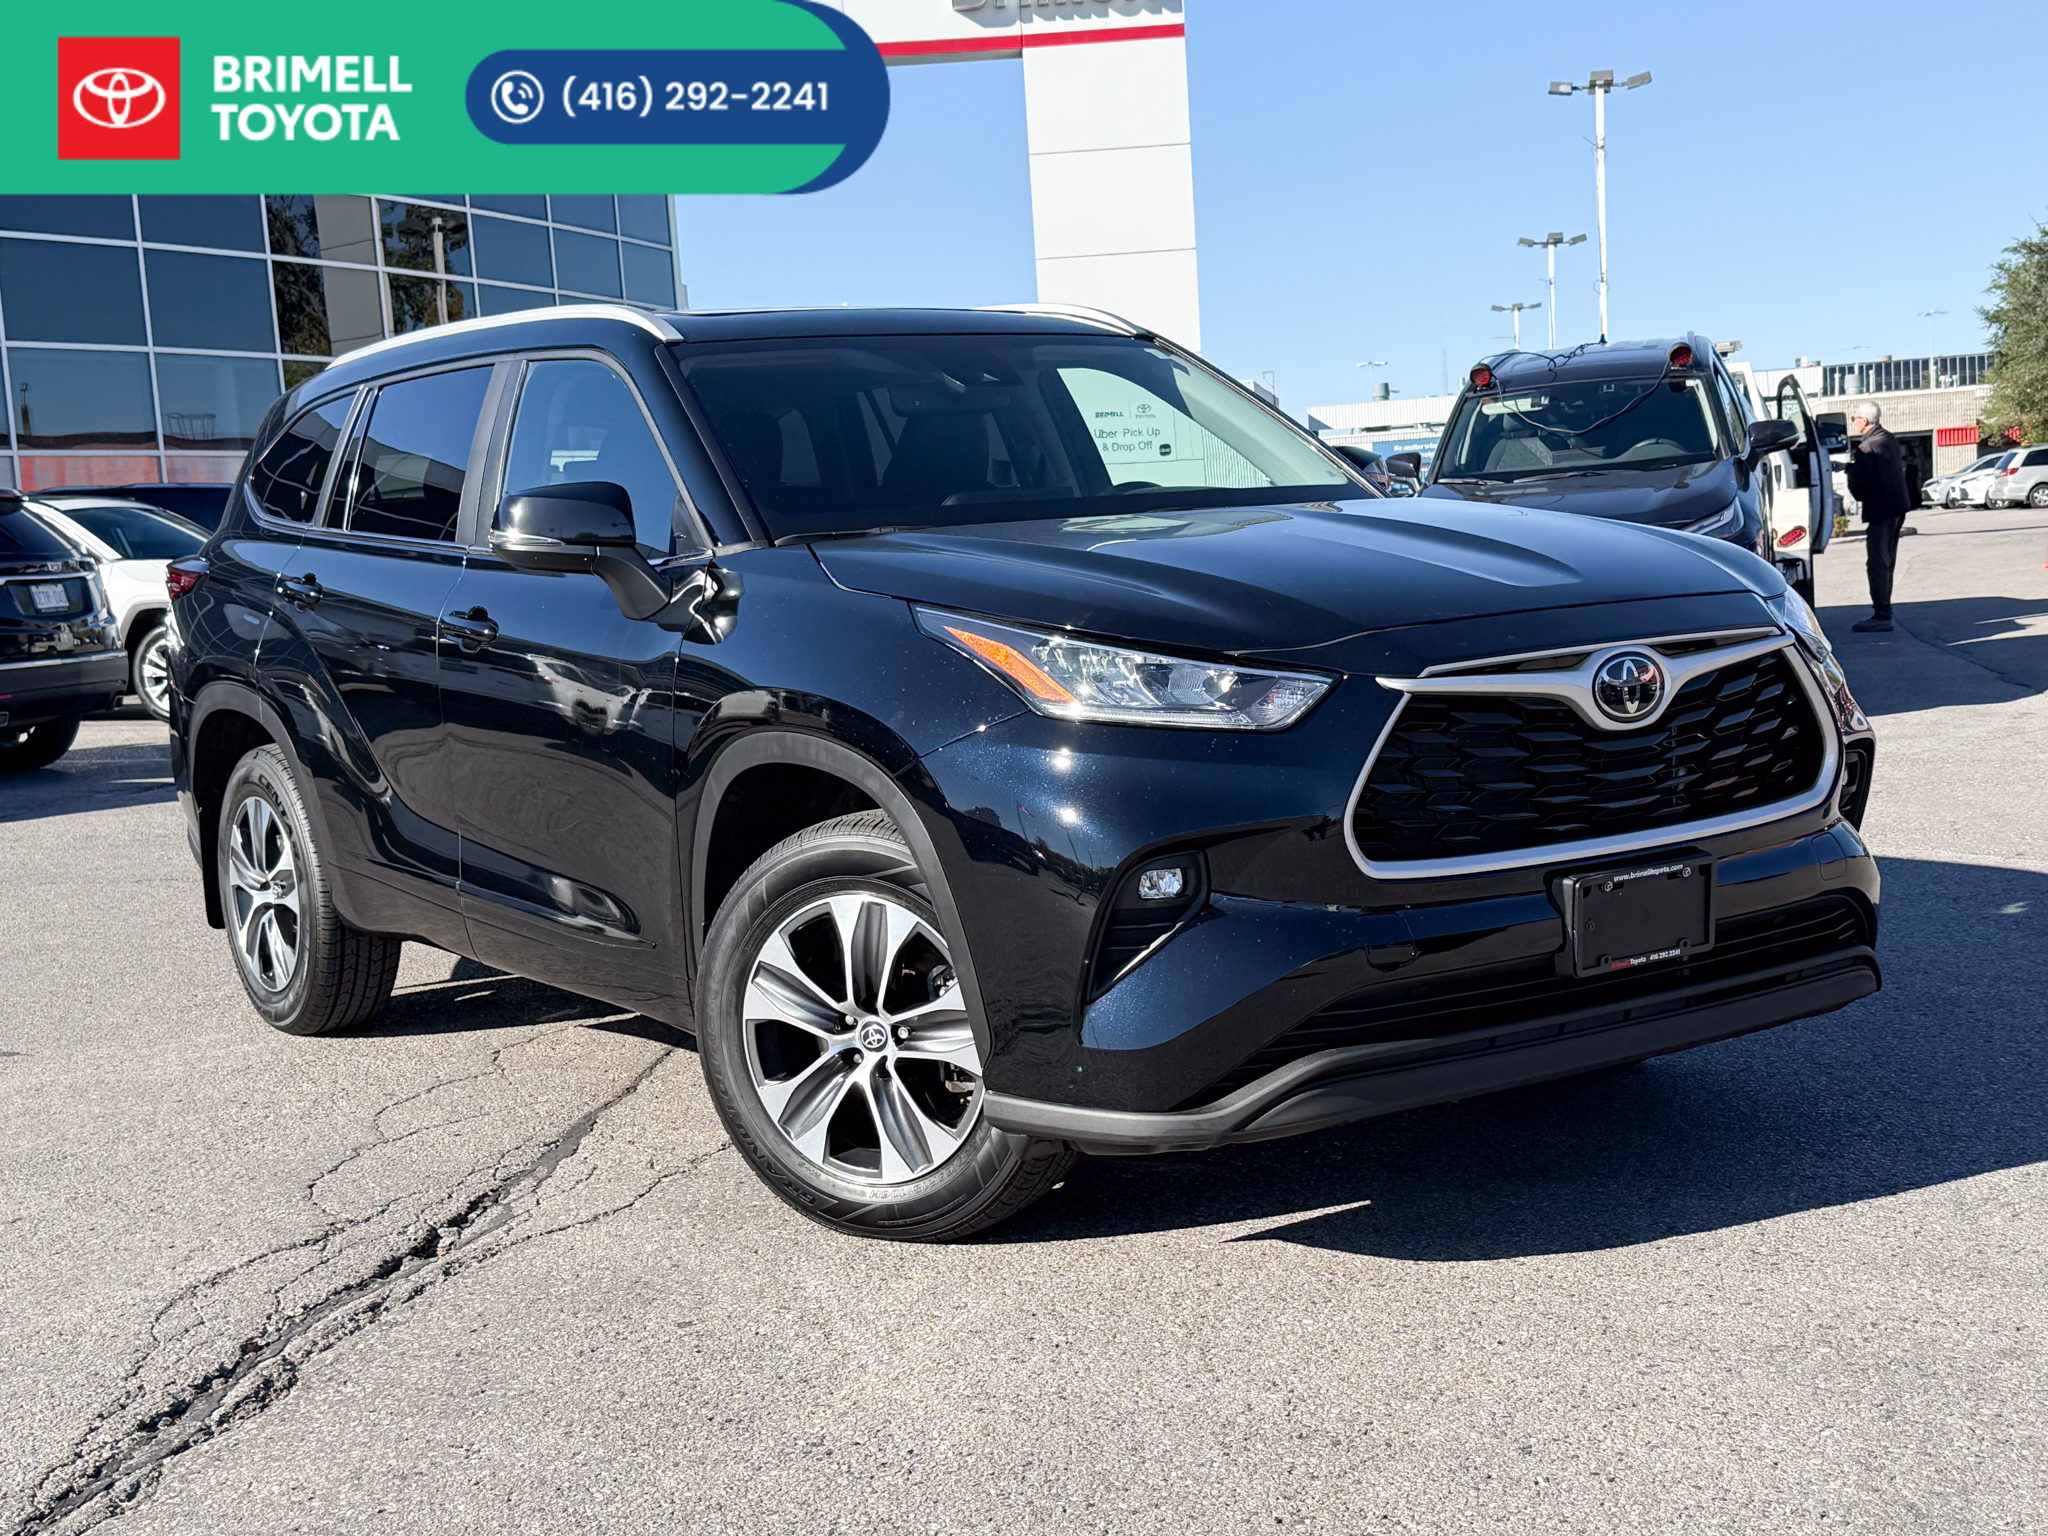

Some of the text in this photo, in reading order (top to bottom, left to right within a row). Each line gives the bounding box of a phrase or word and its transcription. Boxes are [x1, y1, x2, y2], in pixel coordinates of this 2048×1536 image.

[1094, 427, 1160, 438] Uber Pick Up
[1112, 443, 1135, 454] Drop
[1138, 440, 1153, 450] Off
